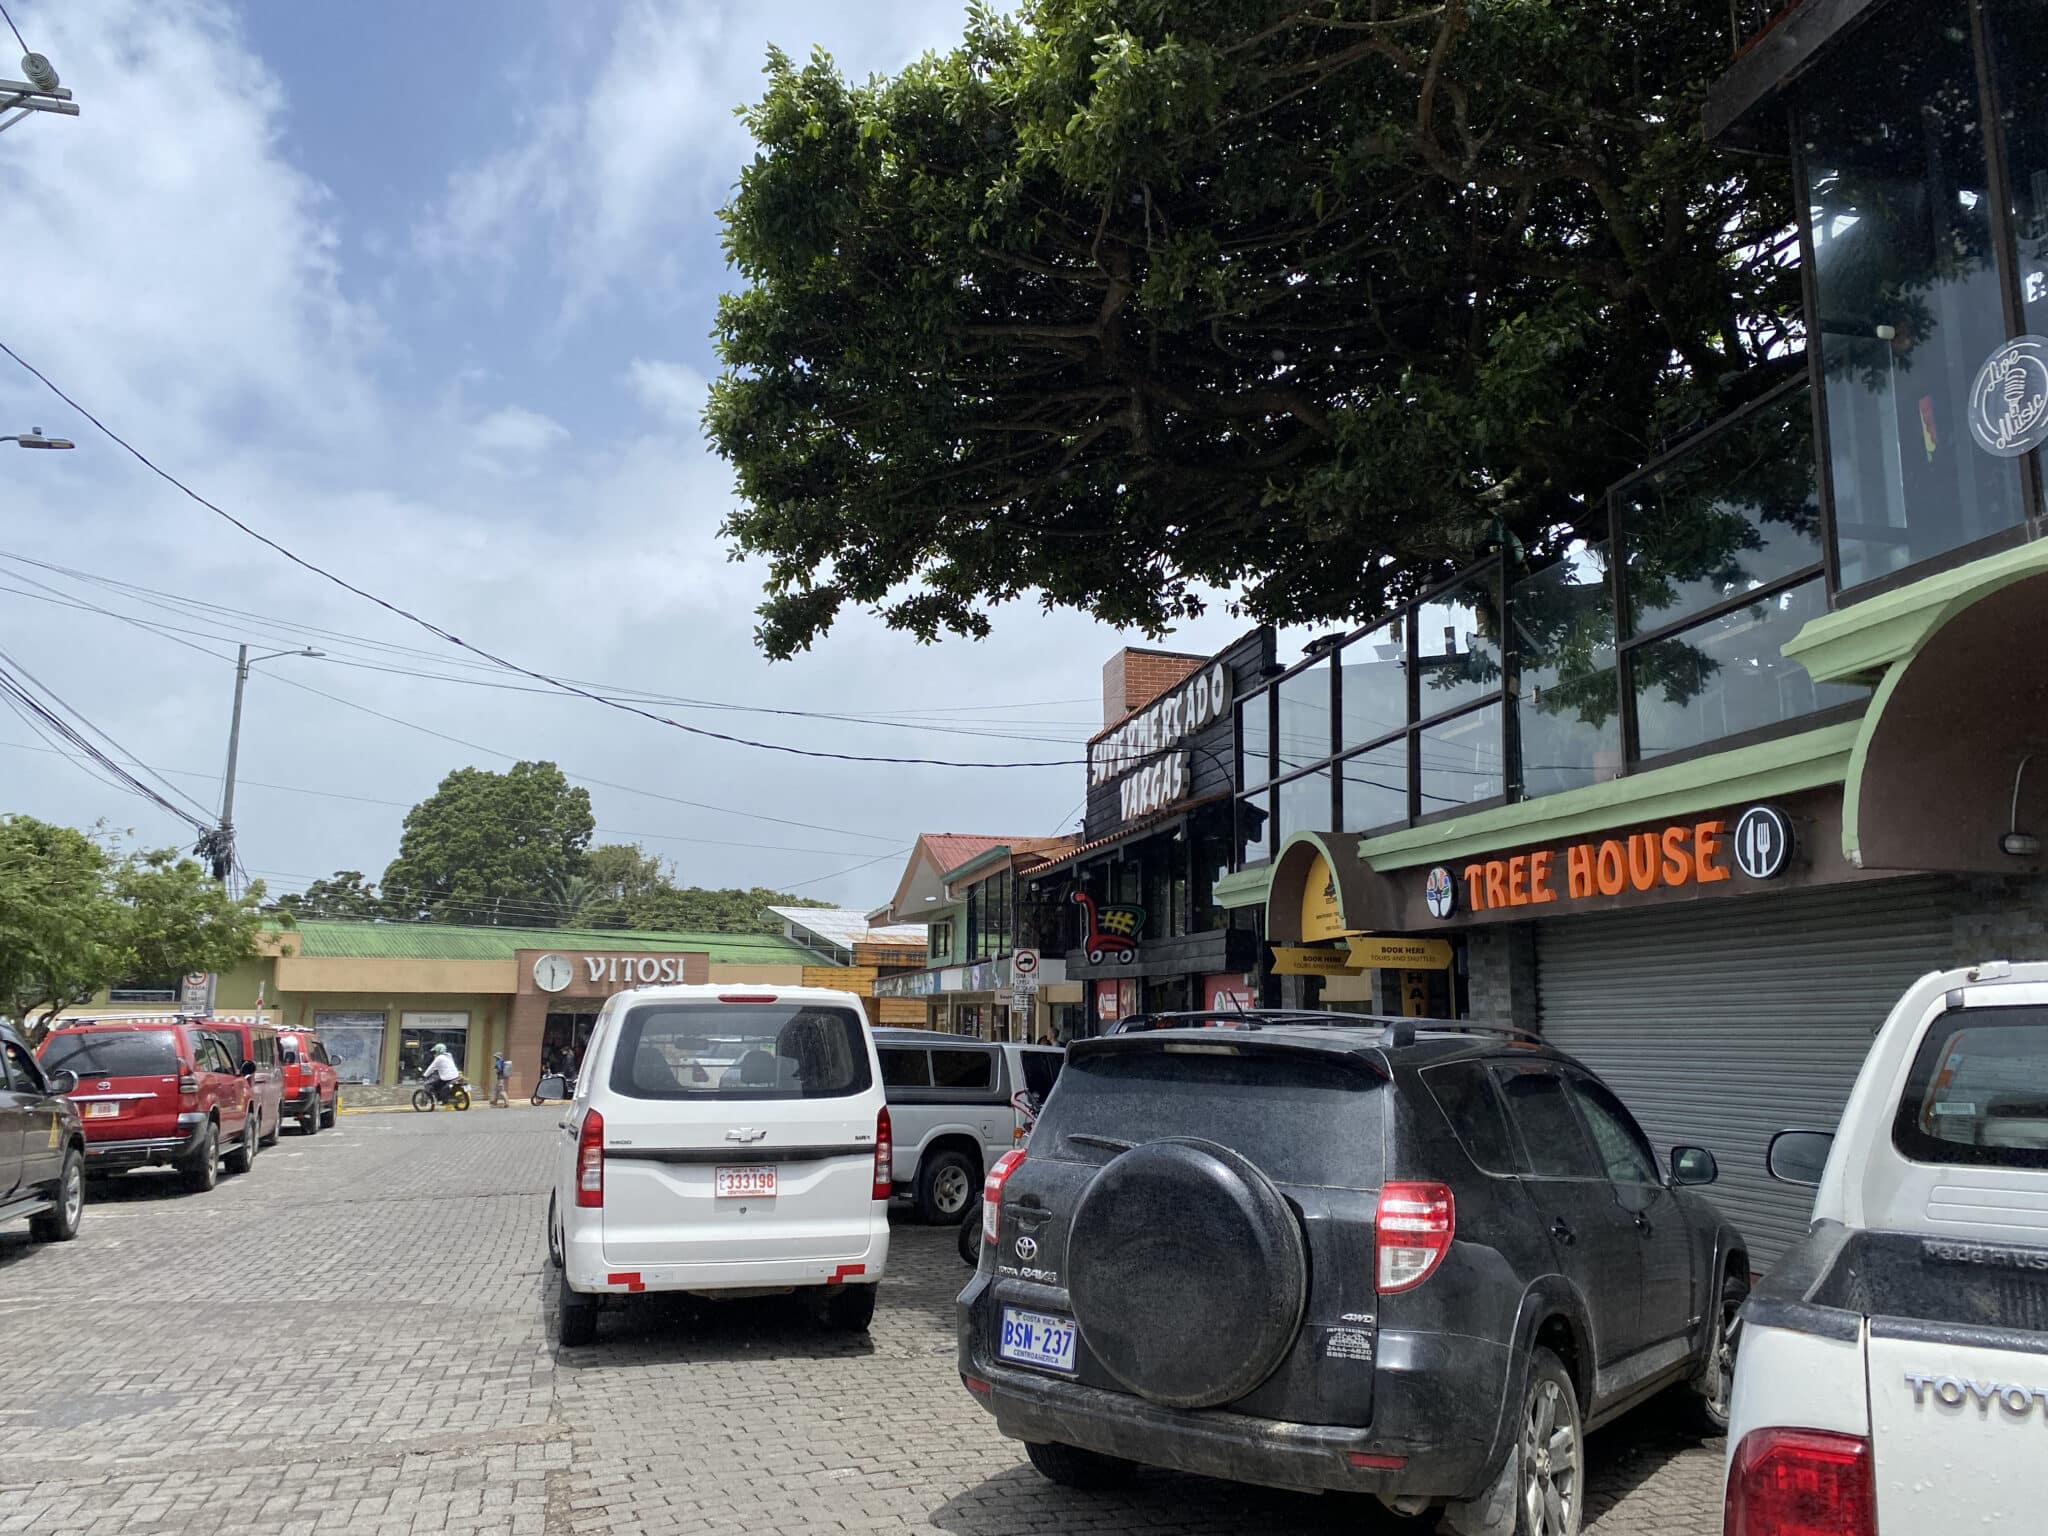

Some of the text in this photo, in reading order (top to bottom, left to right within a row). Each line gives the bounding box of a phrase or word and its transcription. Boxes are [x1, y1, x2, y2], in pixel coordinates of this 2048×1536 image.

[1987, 350, 2019, 391] Live
[1996, 394, 2044, 449] Music
[1091, 662, 1232, 786] SUPERMERCADO
[1120, 749, 1190, 822] VARGAS
[1464, 820, 1731, 912] TREE HOUSE
[583, 956, 685, 983] VITOSI
[1406, 971, 1424, 1016] HAI
[727, 1173, 774, 1189] 333198
[1020, 1266, 1057, 1283] RAV4
[1022, 1313, 1056, 1326] COSTA RICA
[1341, 1312, 1374, 1323] 4WD
[1004, 1320, 1072, 1357] BSN-237
[1013, 1348, 1059, 1364] CENTROAMERICA
[1904, 1371, 2048, 1422] TOYOT
